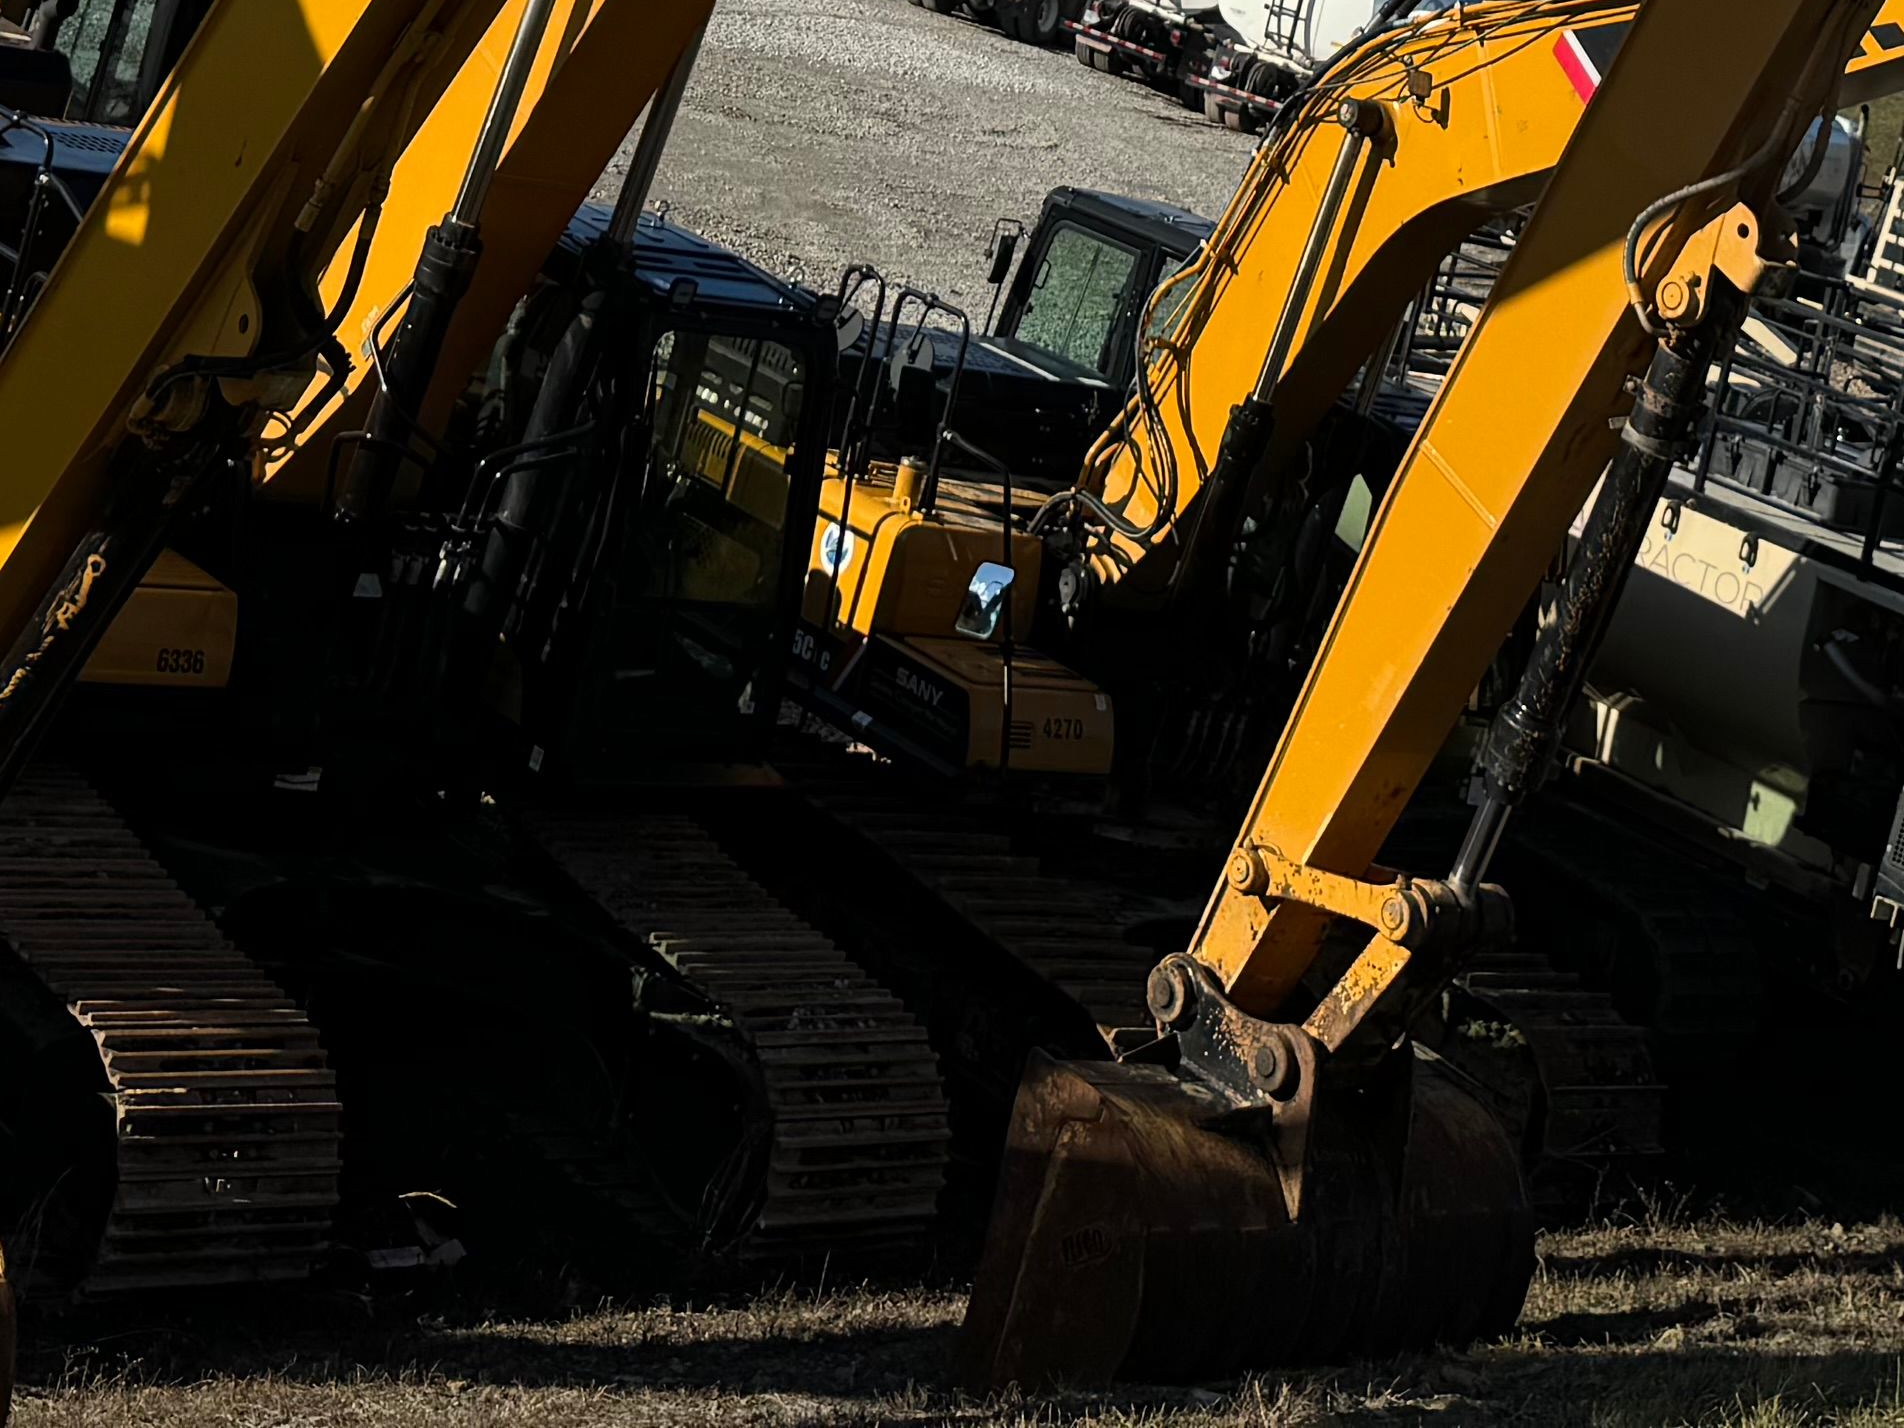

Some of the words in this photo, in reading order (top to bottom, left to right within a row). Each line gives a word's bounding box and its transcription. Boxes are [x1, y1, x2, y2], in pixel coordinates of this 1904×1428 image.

[156, 647, 205, 674] 6336
[895, 666, 944, 707] SANY
[1042, 717, 1084, 740] 4270
